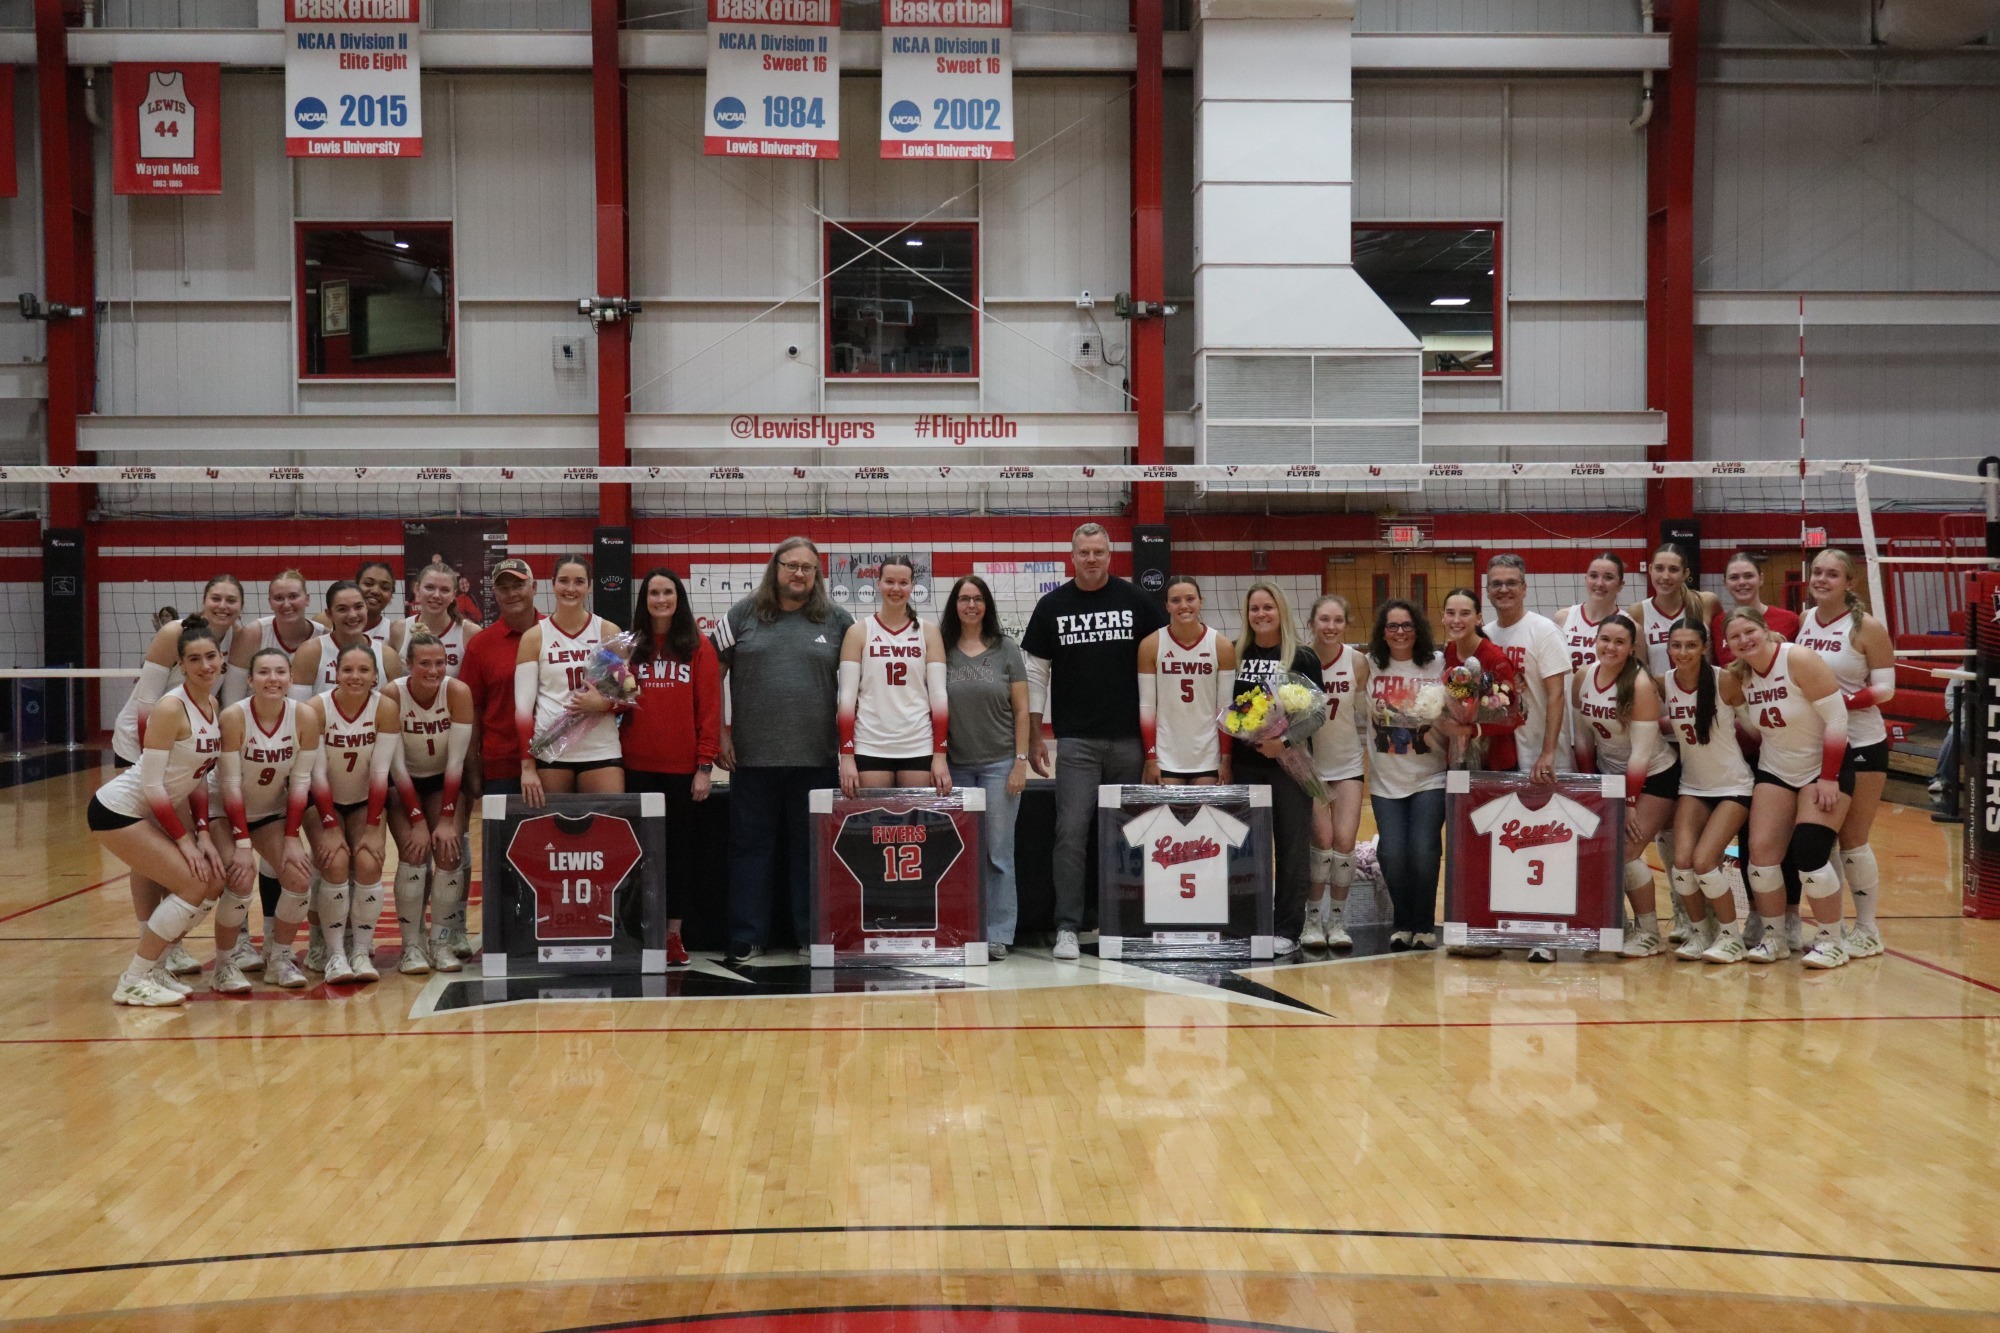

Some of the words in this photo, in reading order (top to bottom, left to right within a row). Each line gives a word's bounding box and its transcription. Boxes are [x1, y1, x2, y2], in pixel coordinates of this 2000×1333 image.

[295, 0, 409, 19] Basketball
[717, 0, 831, 22] Basketball
[890, 0, 1003, 24] Basketball
[297, 33, 336, 49] NCAA
[340, 33, 394, 49] Division
[399, 33, 407, 49] II
[719, 33, 757, 50] NCAA
[761, 34, 814, 52] Division
[819, 37, 827, 52] II
[892, 37, 930, 53] NCAA
[935, 37, 987, 54] Division
[992, 38, 1000, 54] II
[340, 53, 369, 69] Elite
[373, 53, 407, 71] Eight
[763, 54, 808, 72] Sweet
[813, 56, 827, 72] 16
[937, 57, 982, 73] Sweet
[987, 58, 1000, 74] 16
[147, 99, 186, 114] LEWIS
[340, 94, 407, 127] 2015
[763, 95, 826, 128] 1984
[933, 98, 1000, 130] 2002
[297, 112, 327, 122] NCAA
[716, 112, 746, 122] NCAA
[892, 116, 921, 125] NCAA
[154, 120, 179, 137] 44
[308, 140, 341, 154] Lewis
[343, 140, 400, 156] University
[726, 140, 758, 153] Lewis
[760, 141, 817, 157] University
[902, 143, 934, 157] Lewis
[937, 145, 992, 160] University
[136, 163, 170, 176] Wayne
[172, 163, 200, 175] Molis
[730, 415, 875, 446] @LewisFlyers
[914, 415, 1017, 446] #FlightOn
[985, 563, 1017, 575] HOTEL
[1023, 562, 1056, 573] MOTEL
[1039, 581, 1061, 593] INN
[1056, 610, 1134, 634] FLYERS
[1059, 629, 1134, 646] VOLLEYBALL
[548, 649, 591, 664] LEW
[869, 646, 922, 659] LEWIS
[637, 660, 691, 684] EWIS
[885, 662, 907, 686] 12
[1161, 661, 1213, 675] LEWIS
[566, 667, 585, 692] 10
[1324, 681, 1350, 693] WIS
[1180, 679, 1195, 703] 5
[1748, 686, 1788, 705] LEWIS
[1668, 706, 1697, 719] LEW
[1759, 706, 1787, 729] 43
[403, 718, 452, 735] LEWIS
[196, 738, 221, 753] LEW
[325, 732, 376, 748] LEWIS
[426, 739, 435, 756] 1
[244, 747, 293, 763] LEWIS
[343, 752, 358, 773] 7
[257, 767, 276, 786] 9
[1968, 776, 1976, 813] sports
[872, 825, 927, 844] FLYERS
[1500, 819, 1567, 841] Lewis
[1968, 814, 1976, 860] imports
[1152, 835, 1214, 857] Lewis
[549, 851, 604, 871] LEWIS
[883, 844, 922, 882] 12
[1526, 859, 1545, 886] 3
[561, 878, 592, 904] 10
[1180, 873, 1196, 899] 5
